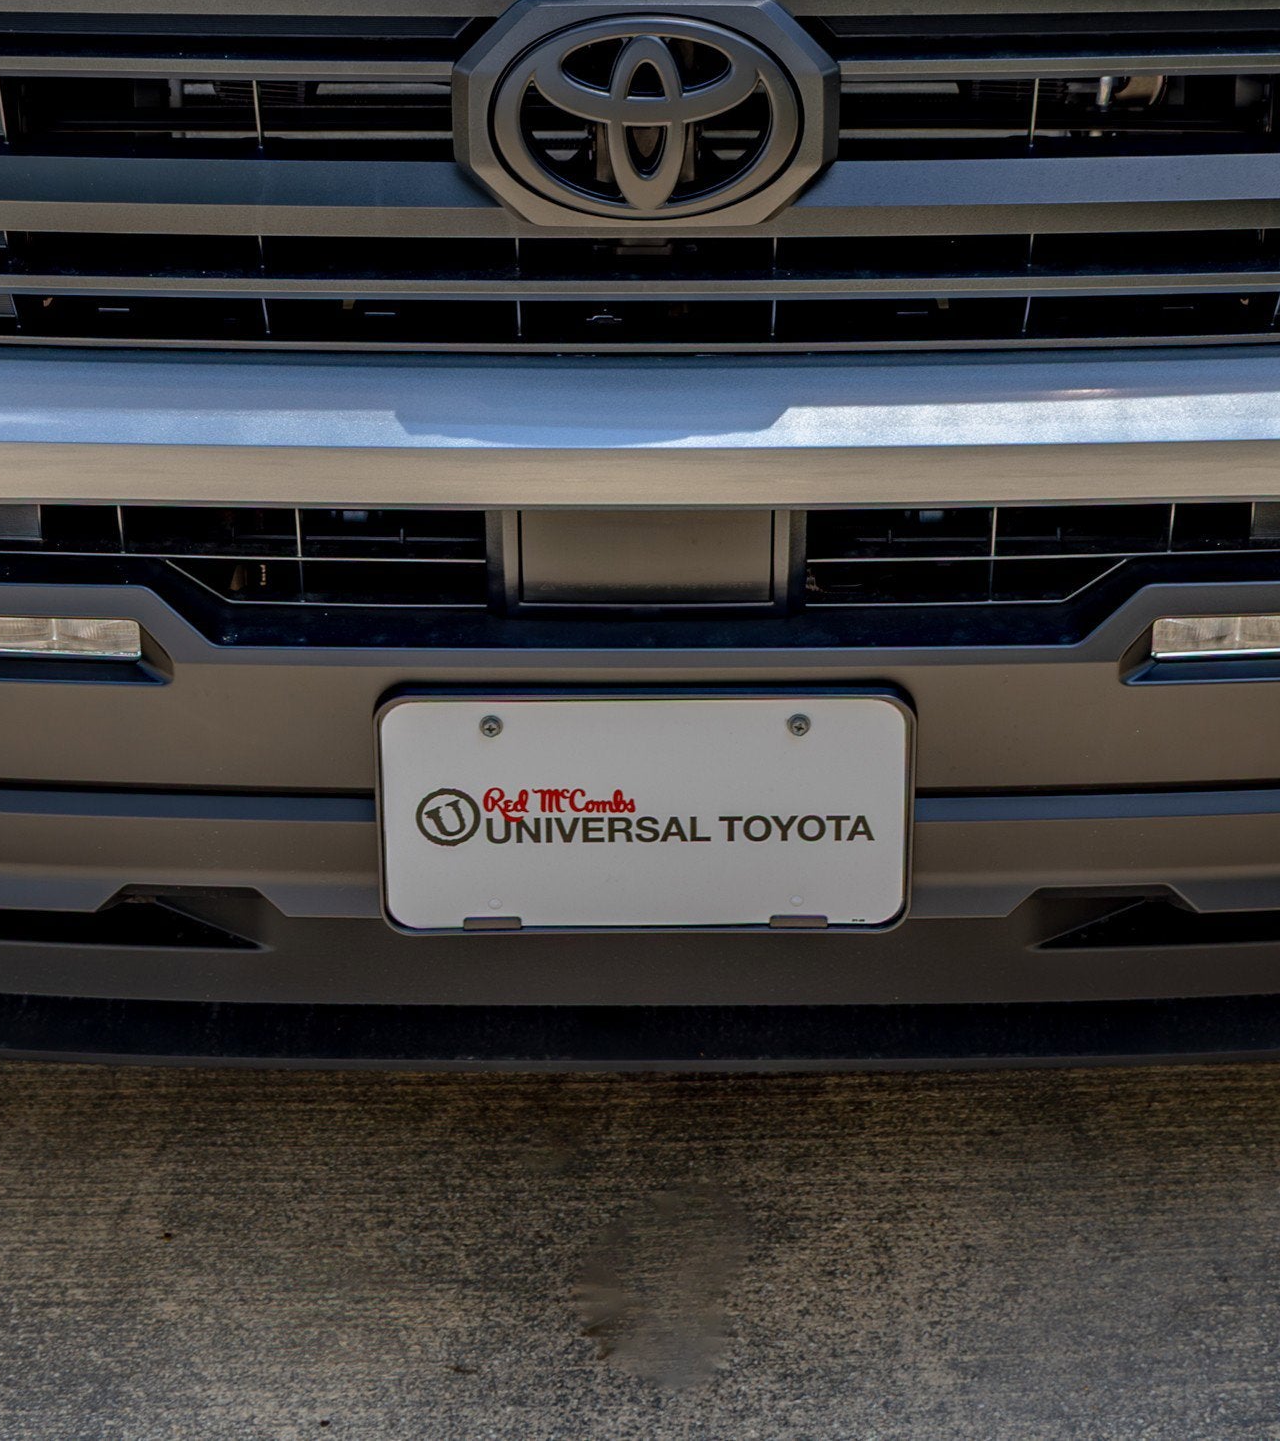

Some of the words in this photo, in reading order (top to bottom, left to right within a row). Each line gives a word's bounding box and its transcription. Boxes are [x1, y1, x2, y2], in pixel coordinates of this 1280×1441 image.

[483, 787, 529, 822] Red
[532, 789, 636, 814] McCombs
[485, 815, 711, 845] UNIVERSAL
[719, 815, 875, 842] TOYOTA
